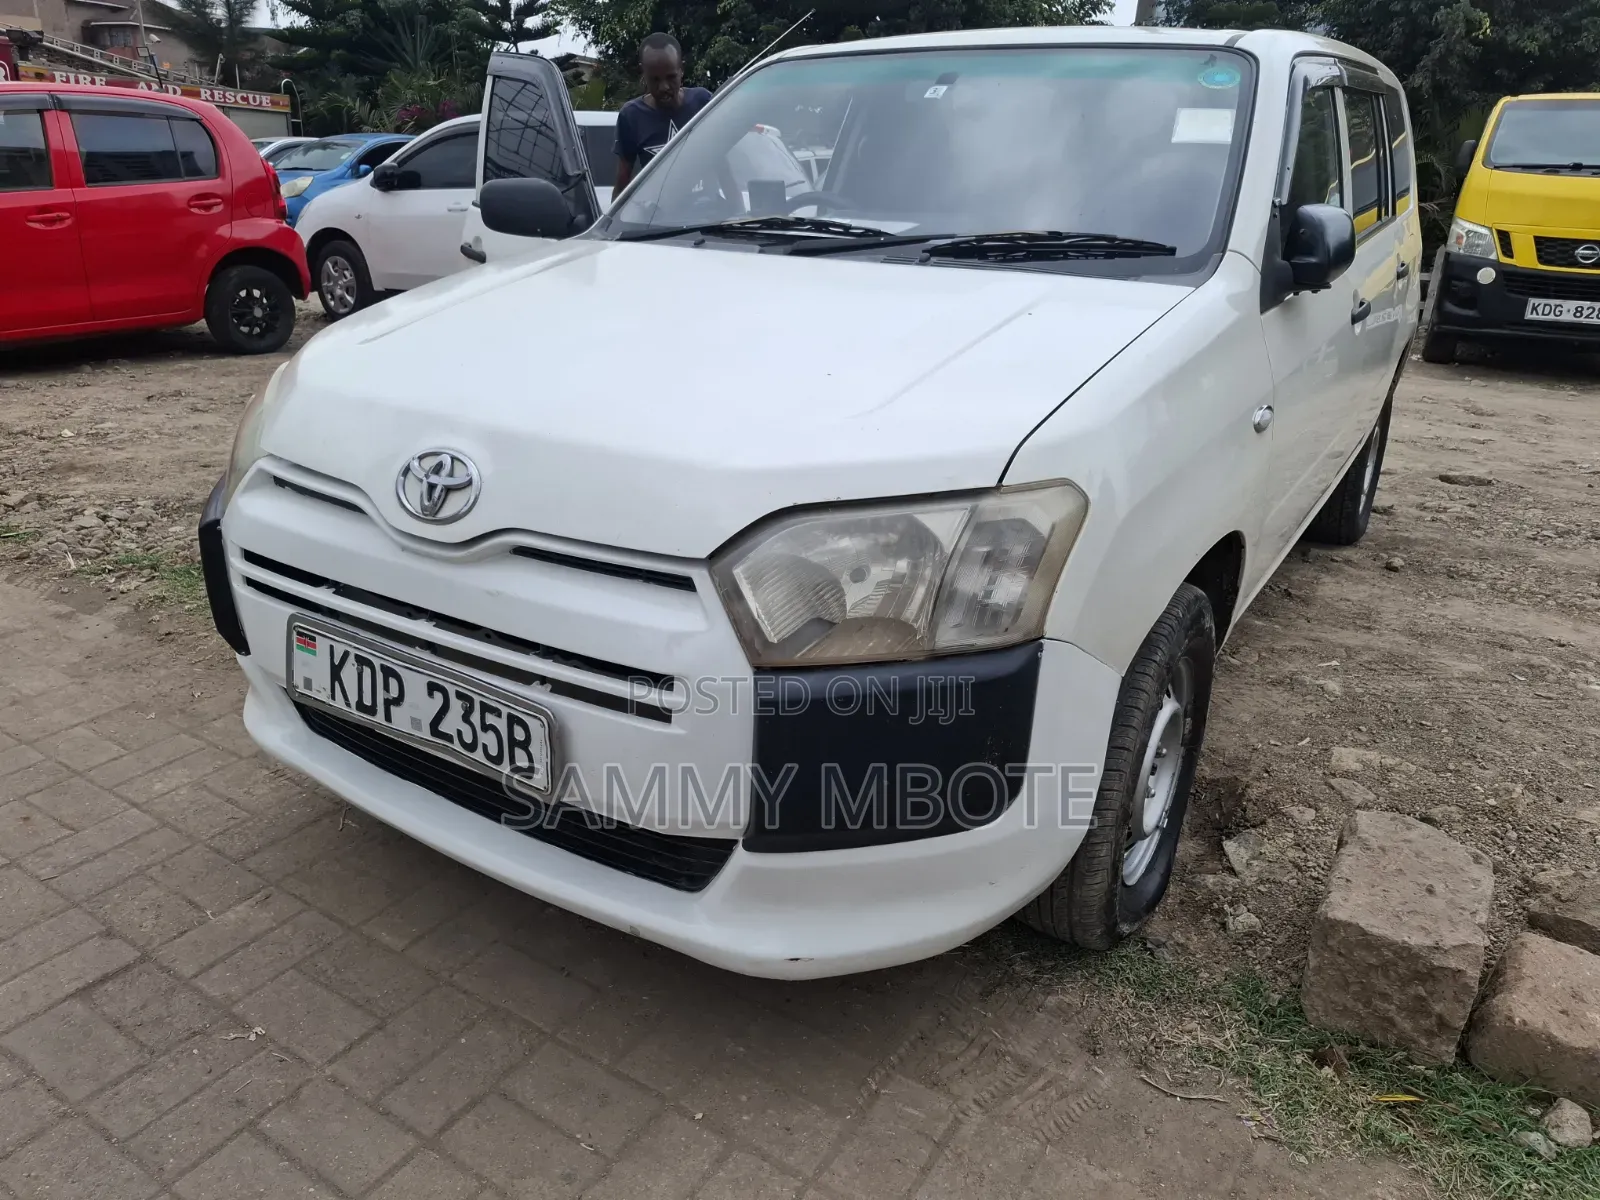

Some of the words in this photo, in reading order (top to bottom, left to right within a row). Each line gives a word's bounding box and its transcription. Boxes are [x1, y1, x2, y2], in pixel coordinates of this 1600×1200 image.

[53, 71, 107, 86] FIRE
[200, 89, 272, 107] RESCUE
[1529, 302, 1564, 318] KDG
[329, 644, 405, 724] KDP
[427, 681, 535, 780] 235B
